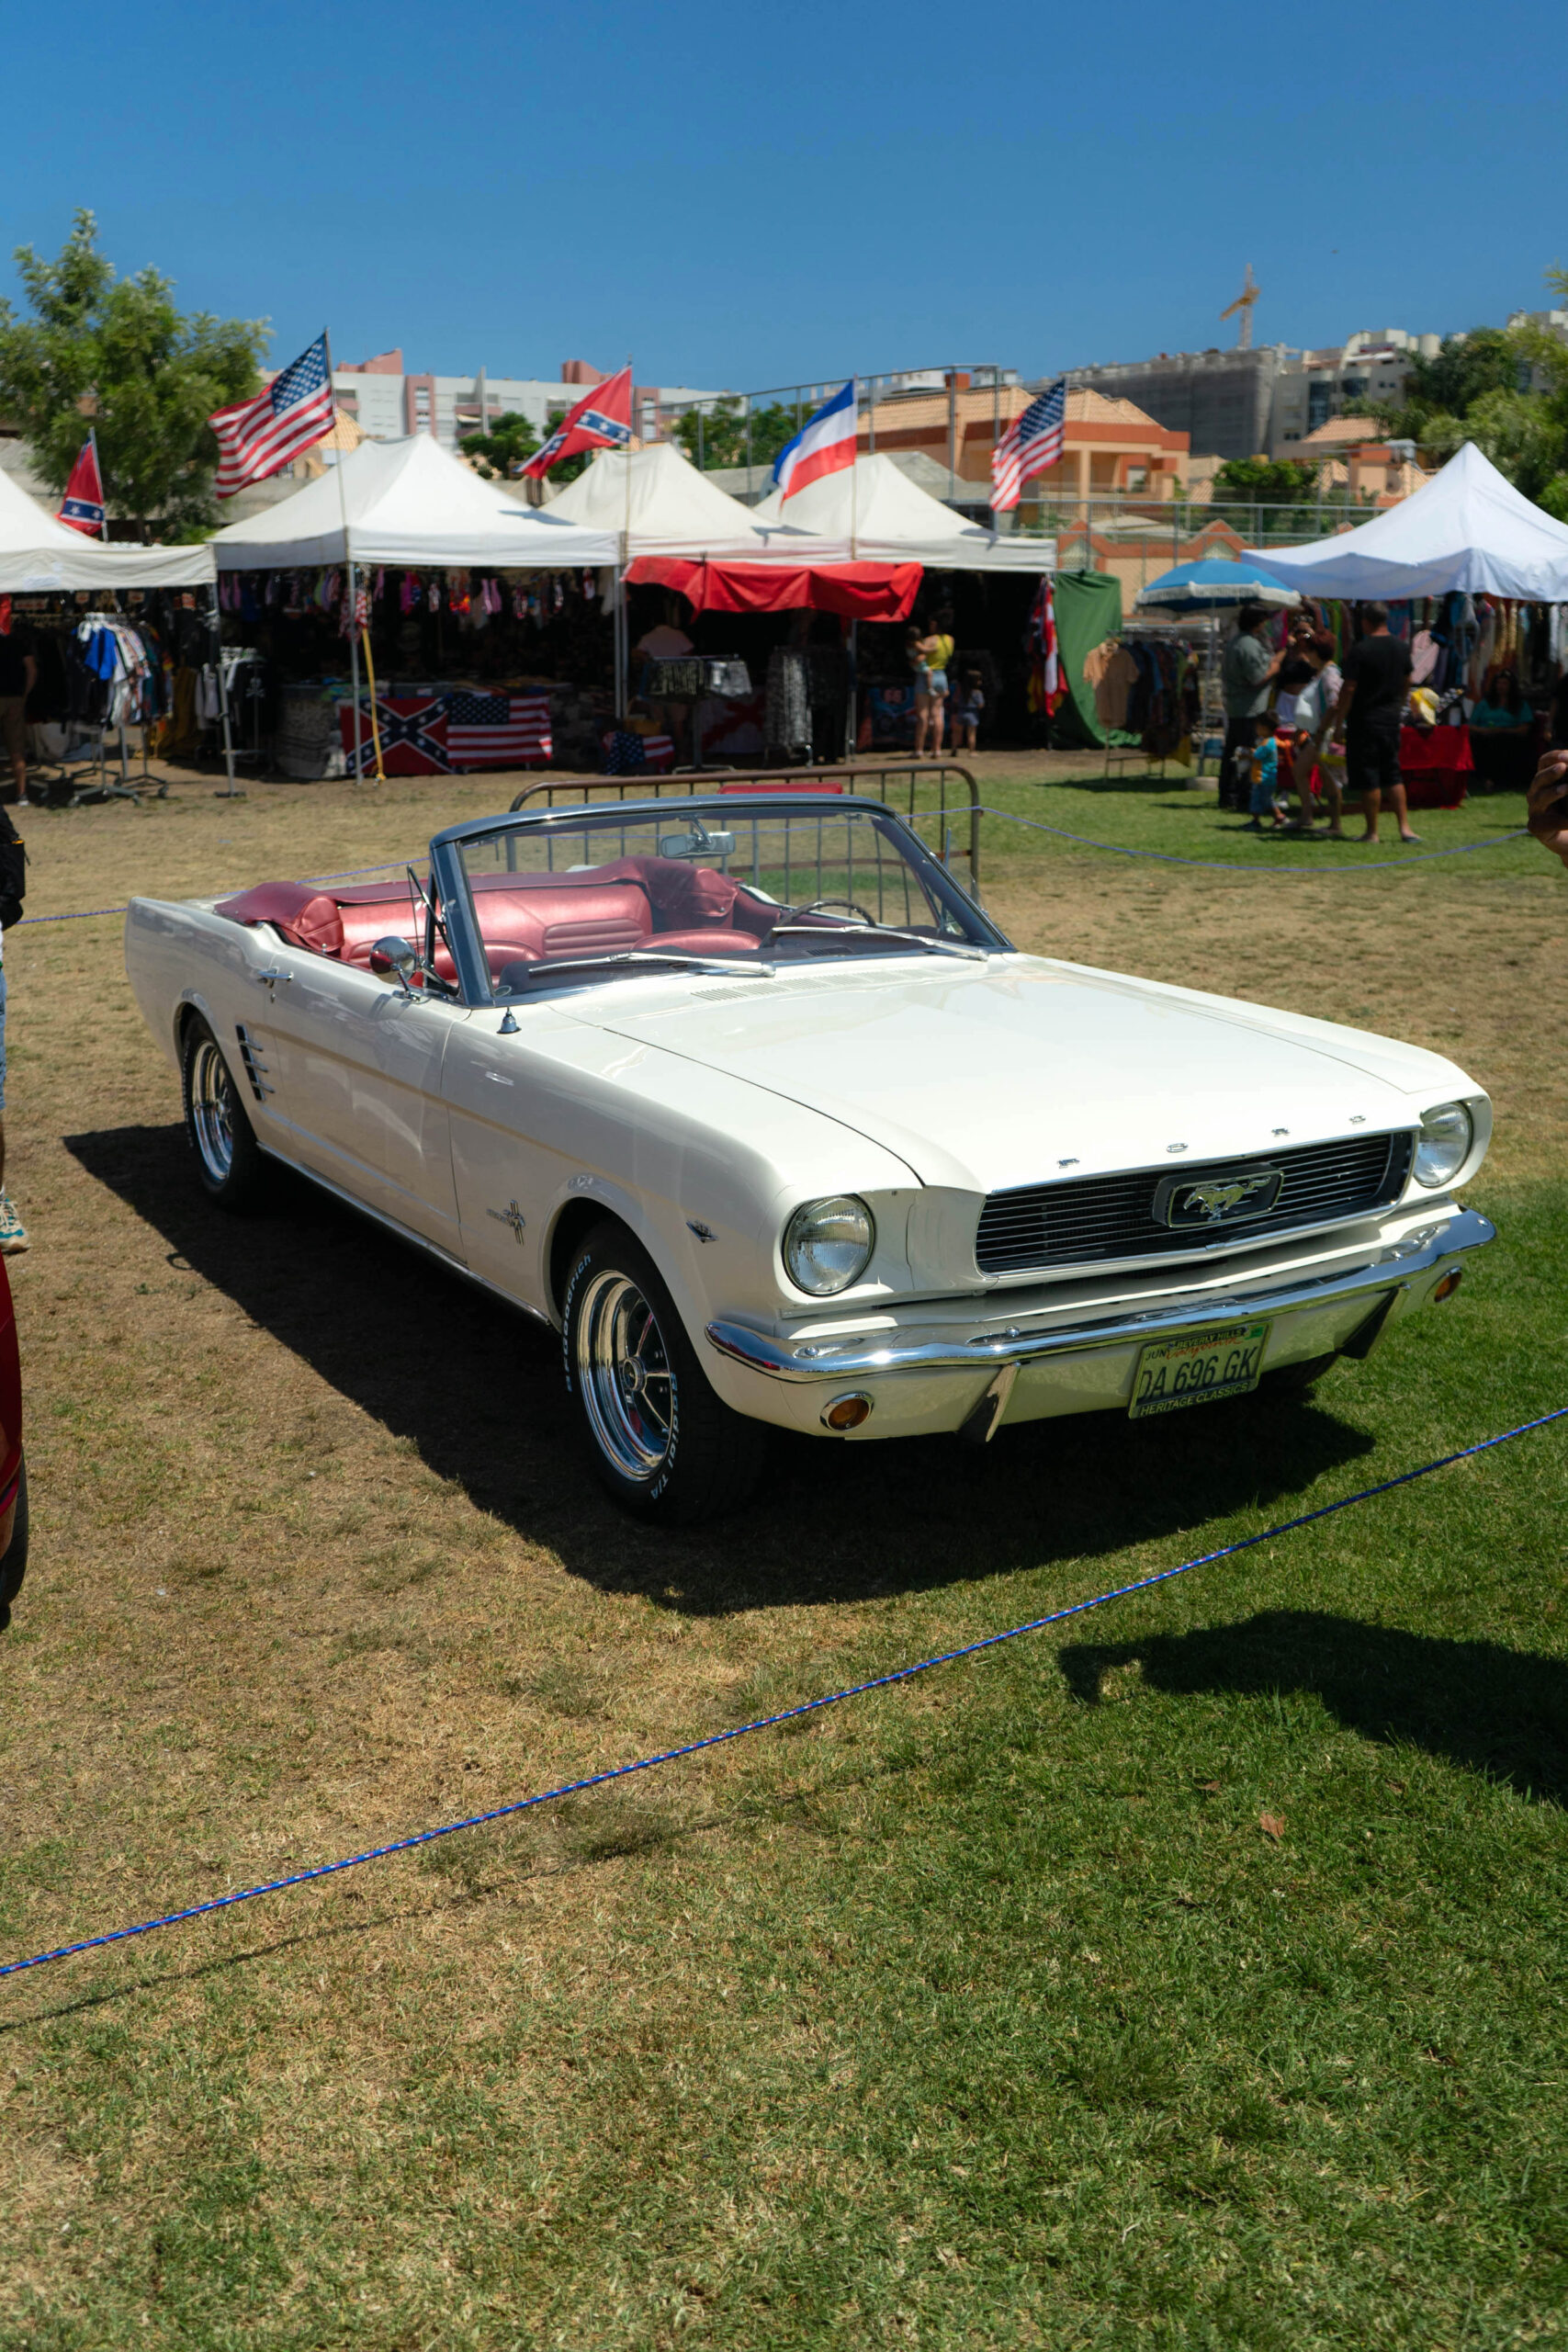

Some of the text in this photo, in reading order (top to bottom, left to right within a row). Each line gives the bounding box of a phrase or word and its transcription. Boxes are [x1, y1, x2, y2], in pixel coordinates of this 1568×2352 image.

[1177, 1334, 1216, 1349] BEVERLY
[1217, 1328, 1242, 1340] HILLS
[1174, 1355, 1219, 1394] 696
[1223, 1346, 1258, 1383] GK
[1139, 1382, 1249, 1417] HERITAGE CLASSICS
[668, 1372, 680, 1470] Radial
